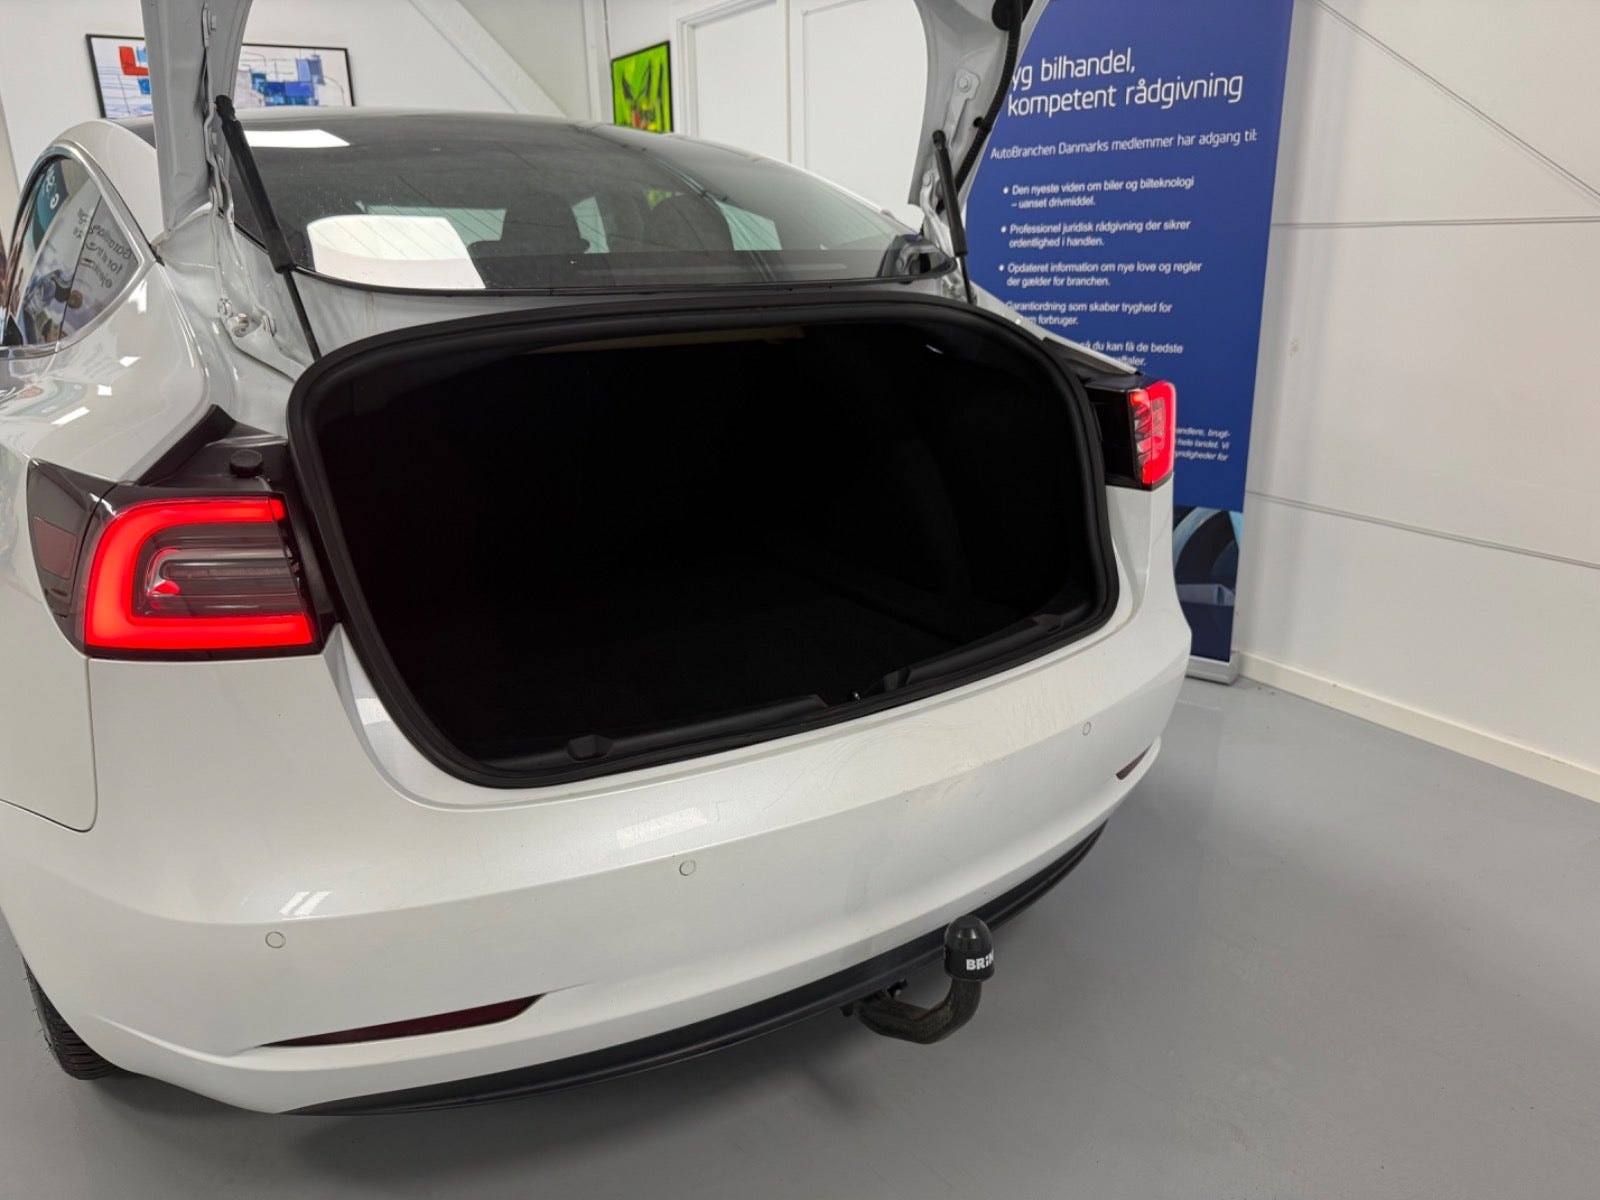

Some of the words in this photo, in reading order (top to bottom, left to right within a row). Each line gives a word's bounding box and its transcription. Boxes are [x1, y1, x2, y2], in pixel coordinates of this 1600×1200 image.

[1041, 47, 1135, 82] bilhandel,
[1007, 85, 1117, 118] kompetent
[1125, 72, 1243, 109] rådgivning
[990, 144, 1056, 159] AutoBranchen
[1058, 140, 1109, 155] Danmarks
[1111, 135, 1174, 151] medlemmer
[1177, 132, 1196, 146] har
[1198, 131, 1241, 148] adgang
[1012, 184, 1030, 196] Den
[1031, 183, 1060, 197] nyeste
[1061, 181, 1085, 193] viden
[1087, 181, 1101, 191] om
[1103, 179, 1123, 190] biler
[1125, 180, 1138, 192] og
[1140, 175, 1196, 190] bilteknologi
[1018, 197, 1048, 209] uanset
[1048, 195, 1096, 207] drivmiddel.
[1009, 223, 1061, 235] Professionel
[1062, 221, 1093, 235] juridisk
[1095, 220, 1144, 234] rådgivning
[1145, 220, 1162, 231] der
[1163, 219, 1191, 231] sikrer
[1009, 238, 1060, 249] ordentlighed
[1066, 236, 1104, 247] handlen.
[1007, 263, 1049, 275] Opdateret
[1050, 262, 1099, 273] information
[1100, 263, 1116, 273] om
[1117, 263, 1135, 275] nye
[1136, 261, 1157, 273] love
[1158, 263, 1172, 275] og
[1173, 261, 1202, 274] regler
[1006, 276, 1021, 287] der
[1022, 276, 1051, 289] gælder
[1053, 276, 1065, 287] for
[1066, 276, 1111, 287] branchen.
[1068, 303, 1088, 312] som
[1089, 301, 1120, 313] skaber
[1121, 301, 1157, 315] tryghed
[1159, 301, 1173, 313] for
[1038, 314, 1079, 328] forbruger.
[1092, 340, 1105, 351] du
[1106, 340, 1124, 352] kan
[1125, 341, 1136, 352] få
[1136, 341, 1150, 353] de
[1151, 342, 1184, 354] bedste
